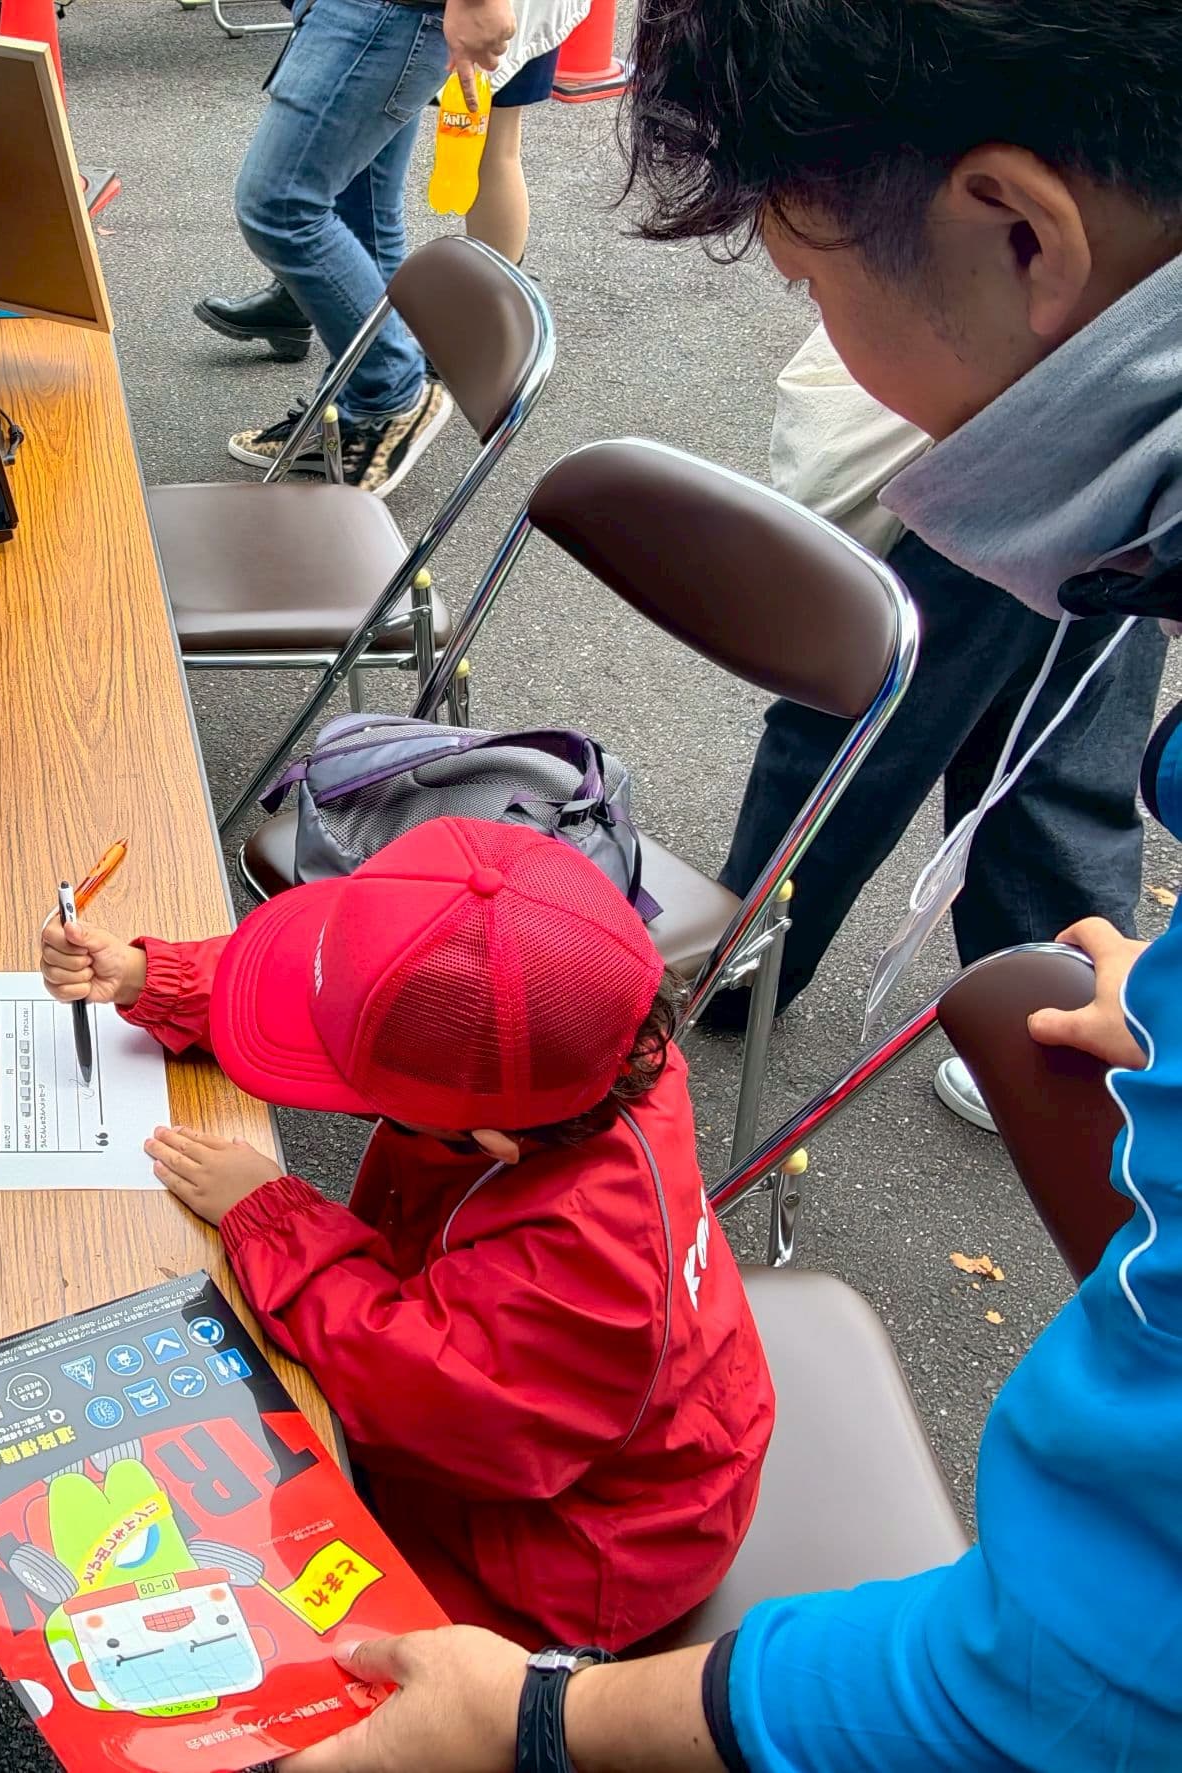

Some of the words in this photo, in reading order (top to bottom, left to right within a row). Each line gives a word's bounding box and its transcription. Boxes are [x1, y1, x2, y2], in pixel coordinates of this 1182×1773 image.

[442, 112, 472, 127] FANTA
[139, 1579, 175, 1595] 10-09
[303, 1558, 359, 1607] とまれ
[164, 1699, 209, 1713] とらっくん
